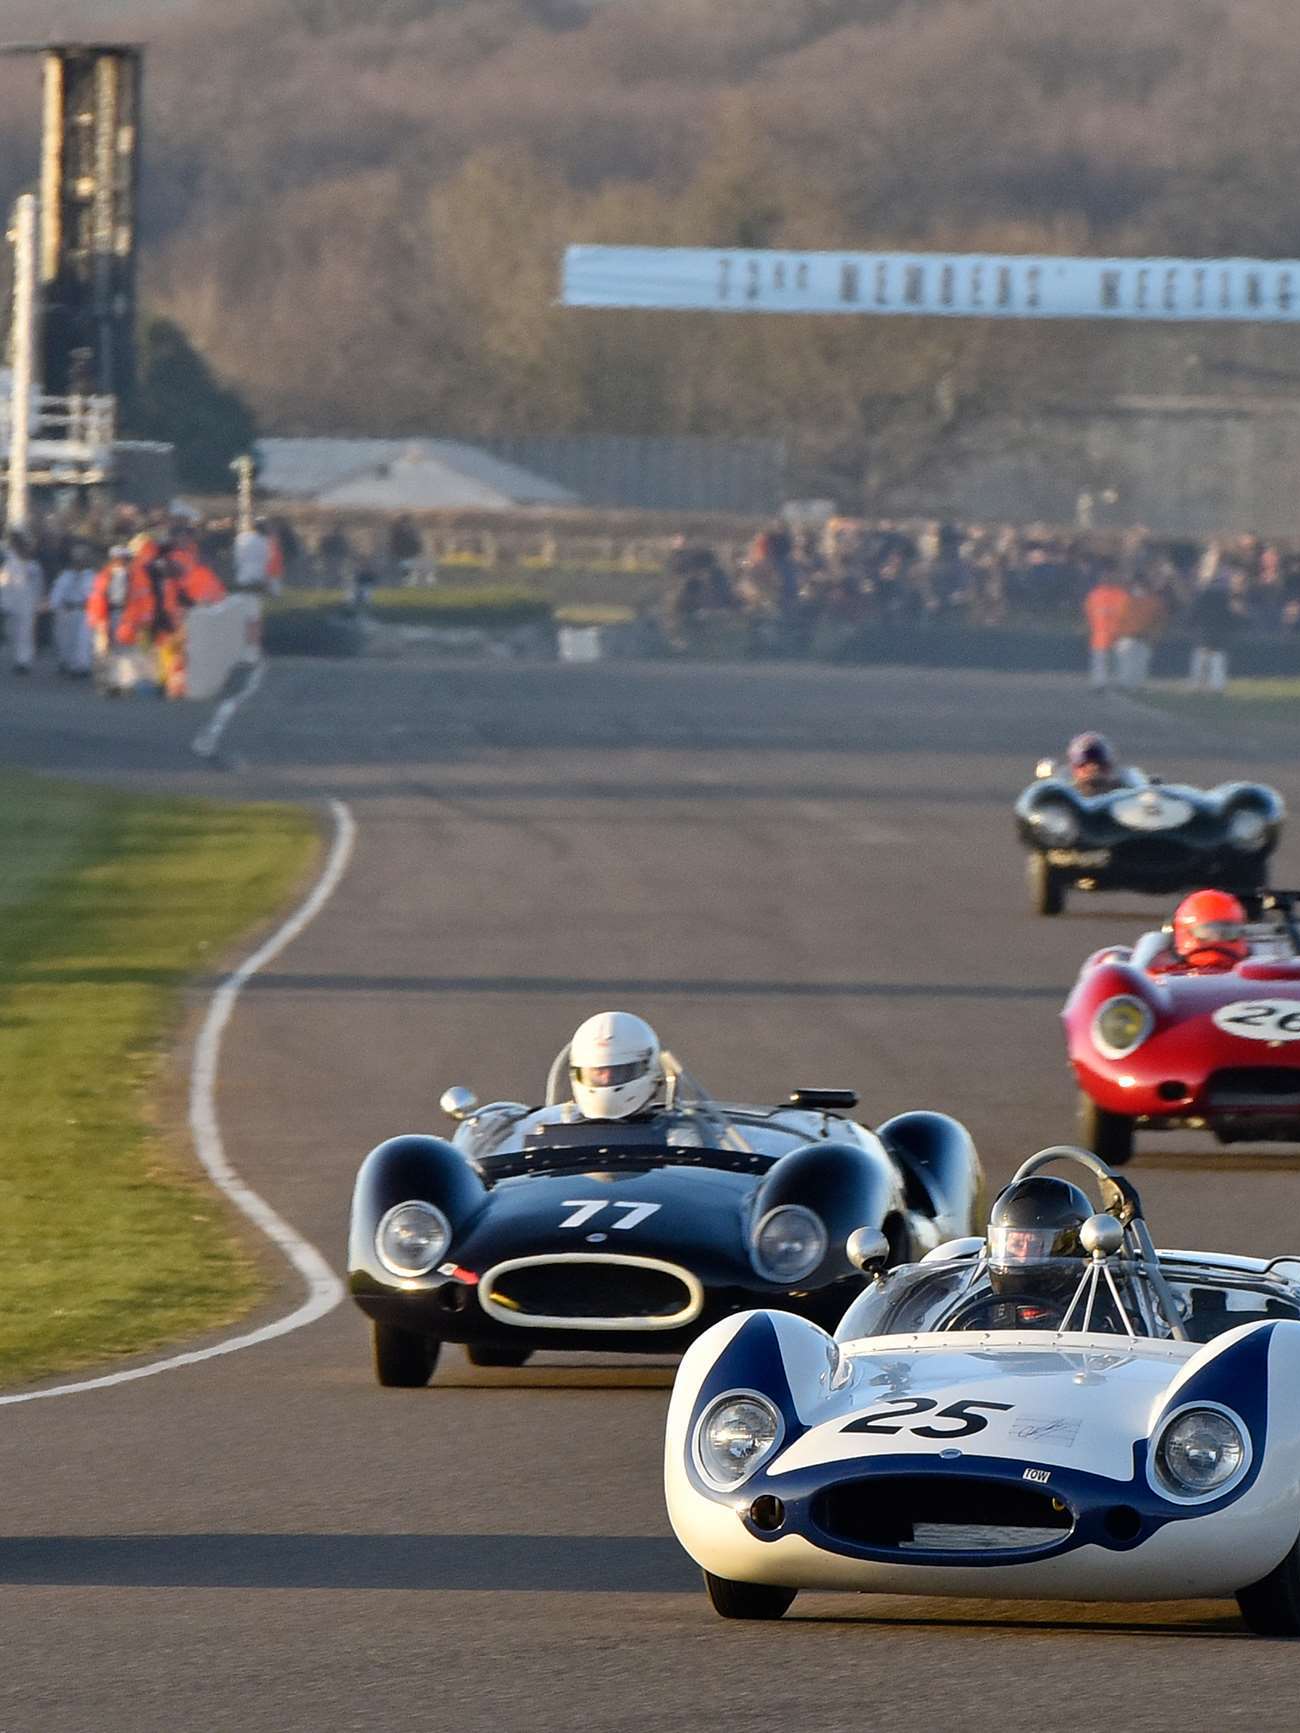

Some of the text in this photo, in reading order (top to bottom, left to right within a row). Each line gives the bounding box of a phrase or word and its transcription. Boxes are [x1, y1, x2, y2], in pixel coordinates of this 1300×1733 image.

[1101, 266, 1292, 310] MEETING
[558, 1200, 662, 1230] 77
[839, 1398, 1015, 1439] 25
[1026, 1468, 1048, 1481] TOW
